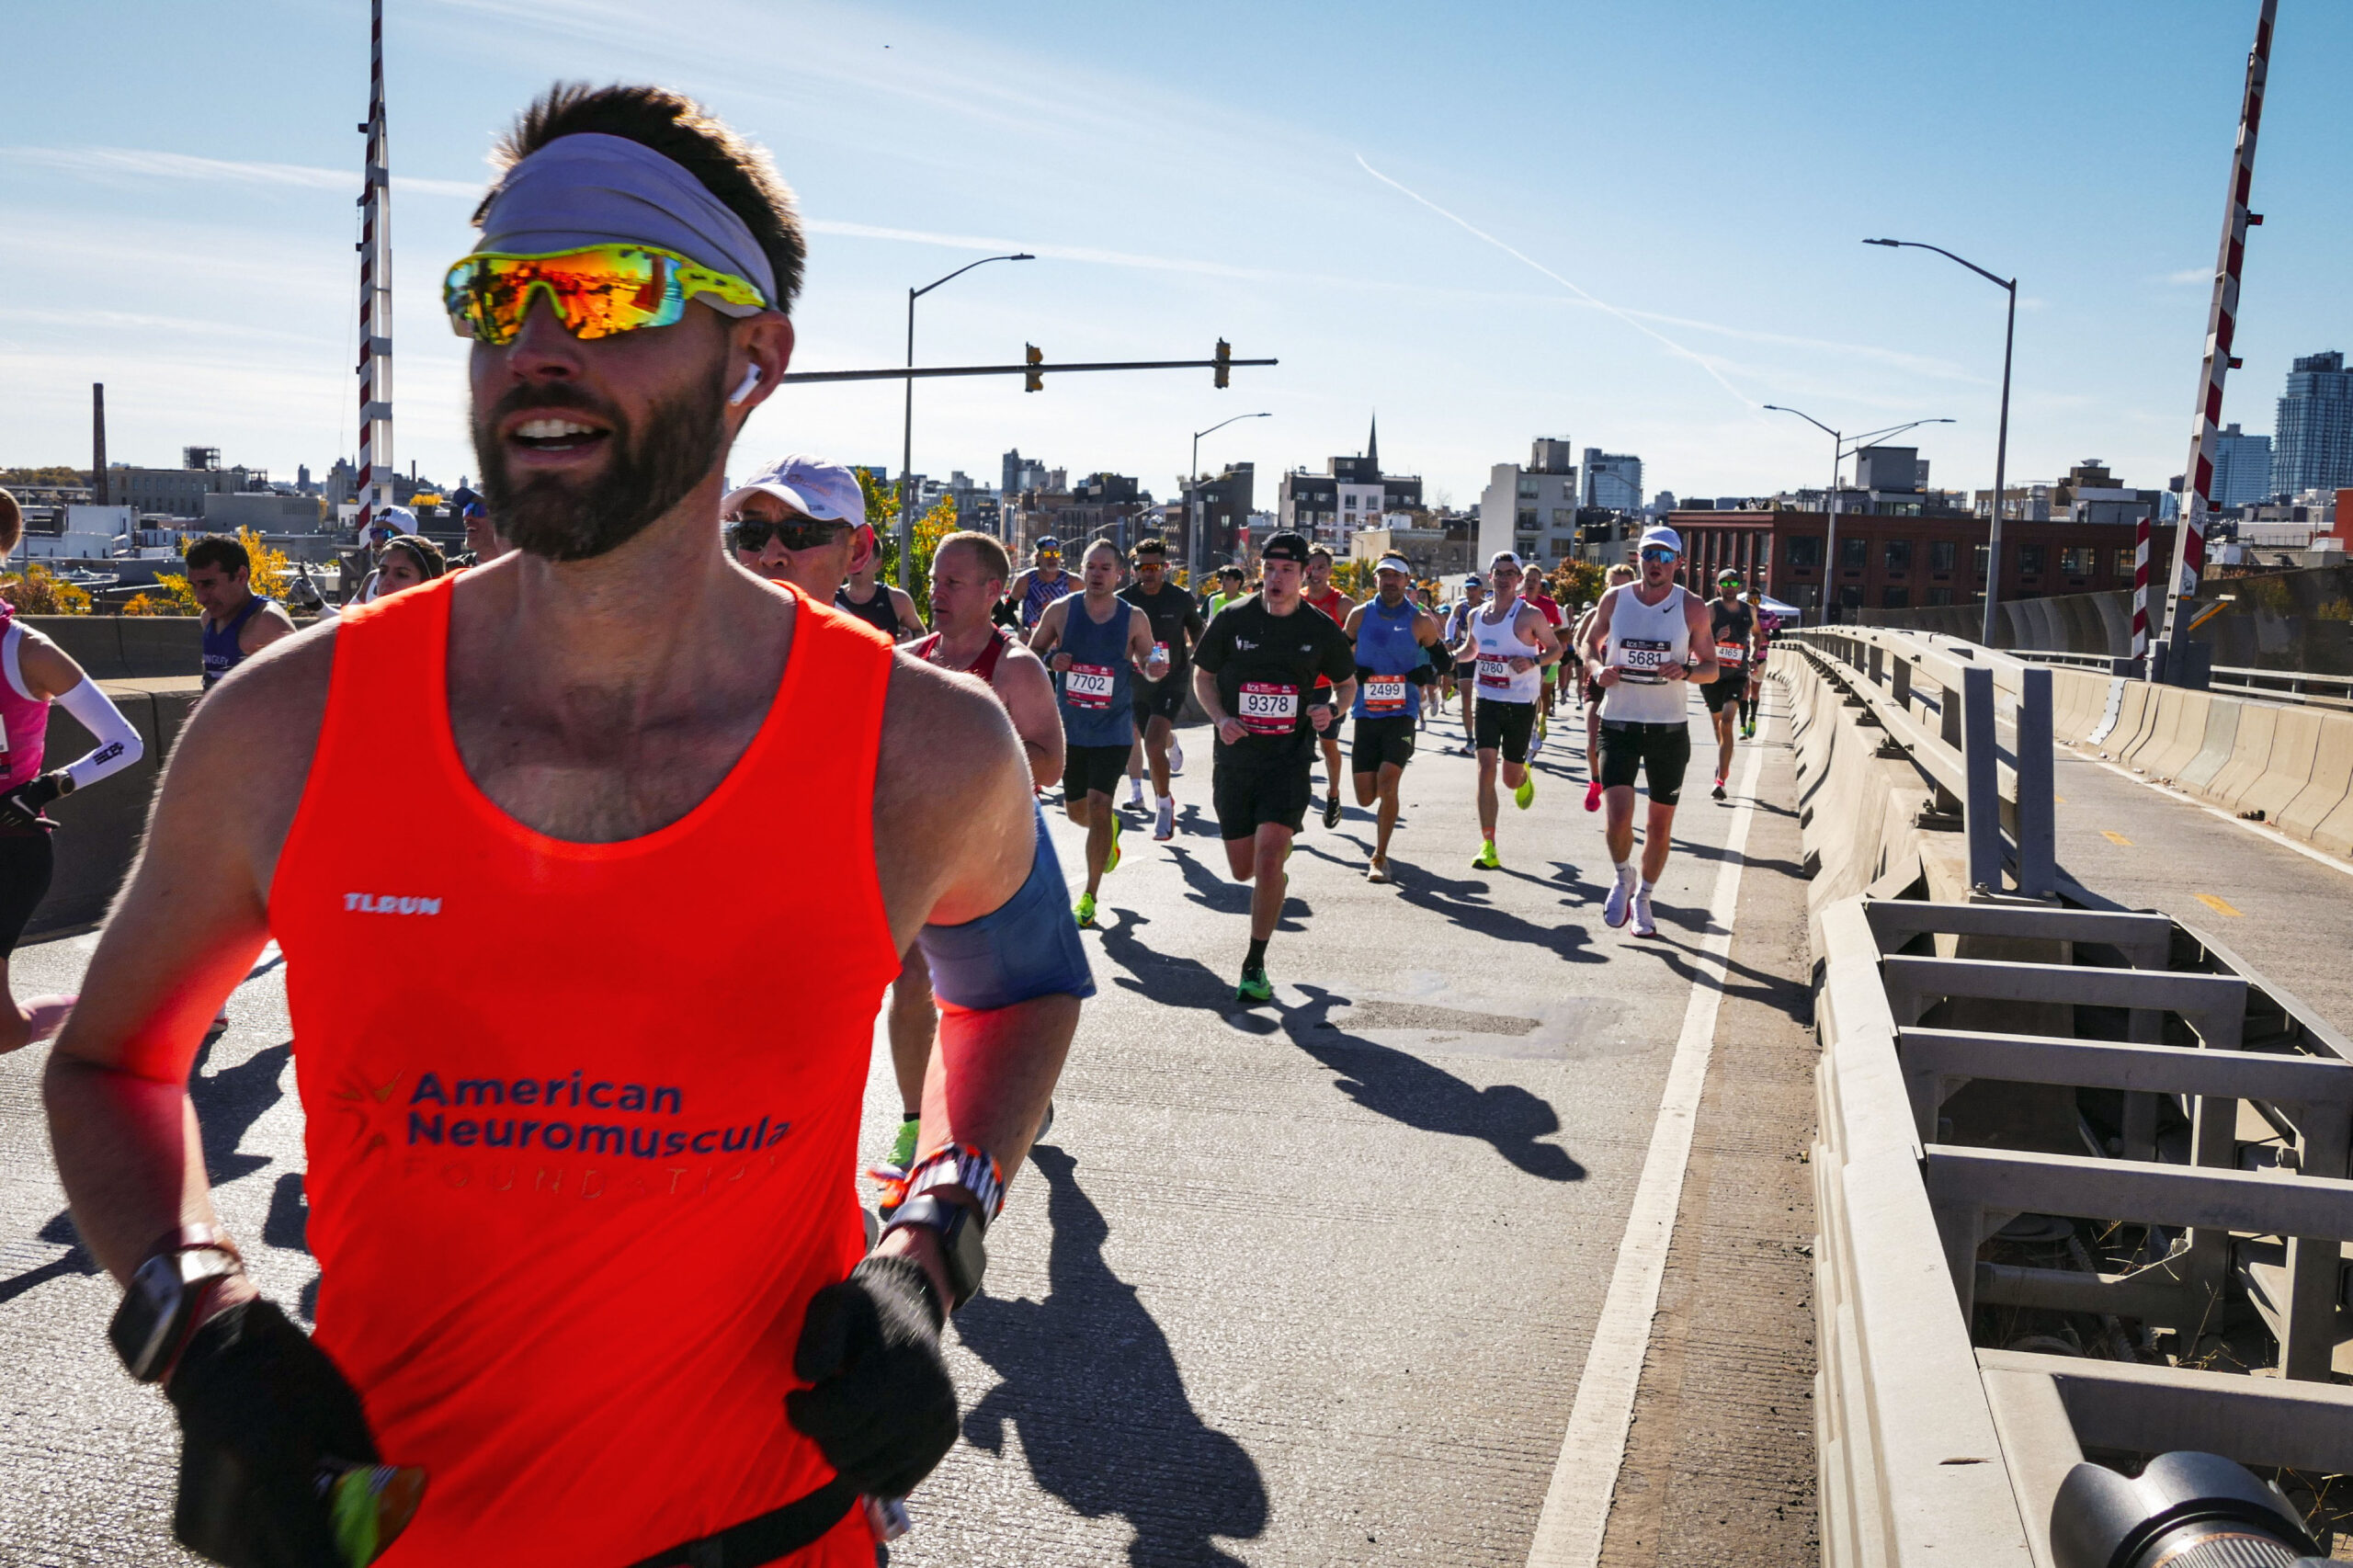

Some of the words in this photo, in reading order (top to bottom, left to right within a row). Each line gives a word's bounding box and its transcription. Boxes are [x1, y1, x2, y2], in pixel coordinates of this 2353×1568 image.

[1628, 650, 1662, 665] 5681
[1719, 647, 1738, 657] 4165
[1480, 661, 1503, 674] 2780
[1074, 674, 1105, 691] 7702
[1370, 684, 1400, 696] 2499
[1248, 695, 1289, 712] 9378
[410, 1069, 682, 1115] American
